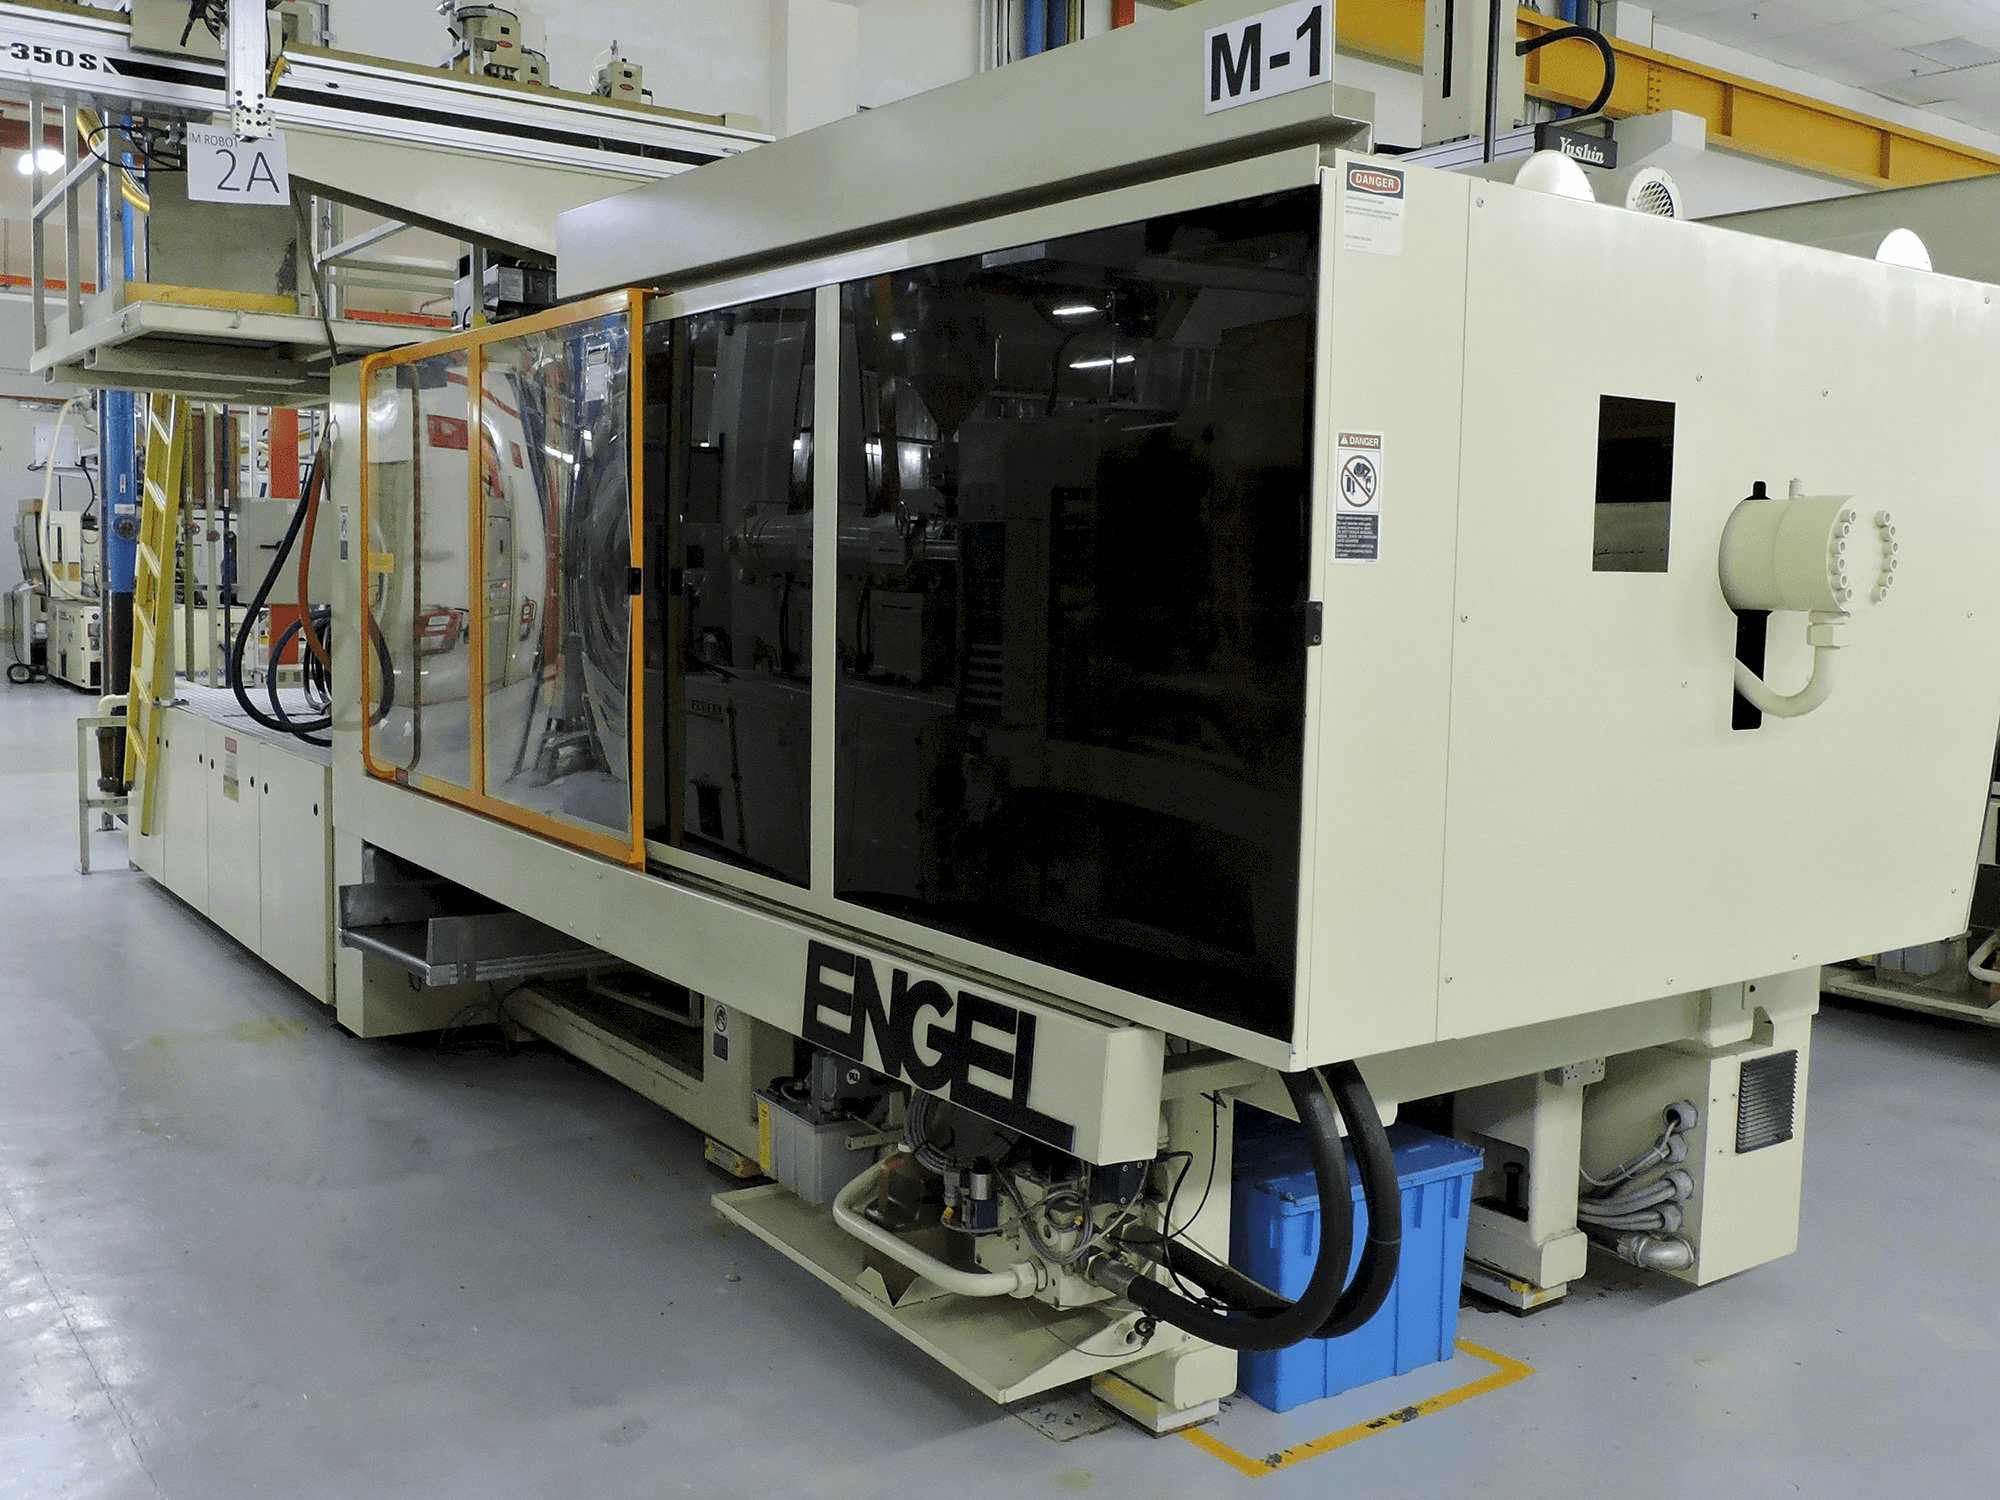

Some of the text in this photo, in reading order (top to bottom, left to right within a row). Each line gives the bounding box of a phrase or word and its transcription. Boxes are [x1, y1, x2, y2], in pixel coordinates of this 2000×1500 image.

[1210, 5, 1322, 101] M-1
[204, 134, 238, 148] ROBOT
[1560, 136, 1604, 164] Yushin
[216, 148, 280, 194] 2A
[1355, 173, 1395, 189] DANGER
[1349, 436, 1379, 447] DANGER
[802, 939, 1076, 1153] ENGEL
